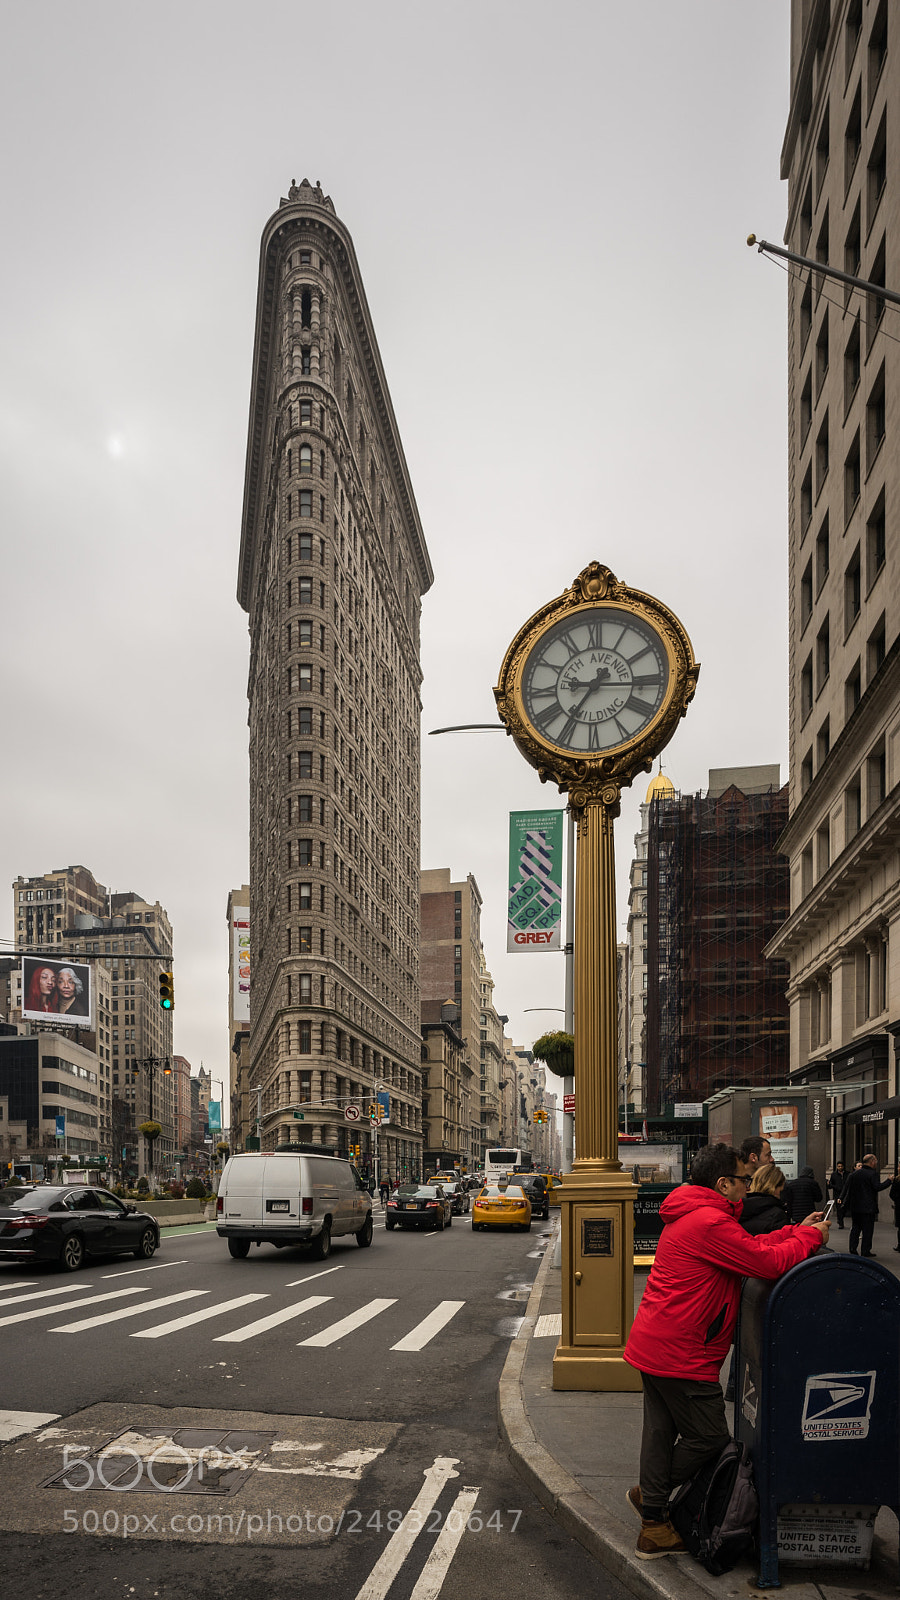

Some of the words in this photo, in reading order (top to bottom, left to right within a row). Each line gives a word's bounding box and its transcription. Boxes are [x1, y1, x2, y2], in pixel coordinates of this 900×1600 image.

[560, 658, 585, 690] FIFTH
[590, 652, 630, 681] AVENUE
[508, 886, 538, 915] MAD.
[518, 907, 541, 926] SQ.
[514, 931, 554, 945] GREY
[803, 1423, 834, 1431] UNITED
[780, 1532, 816, 1542] UNITED
[818, 1534, 857, 1544] STATES
[777, 1542, 815, 1552] POSTAL
[818, 1544, 862, 1554] SERVICE
